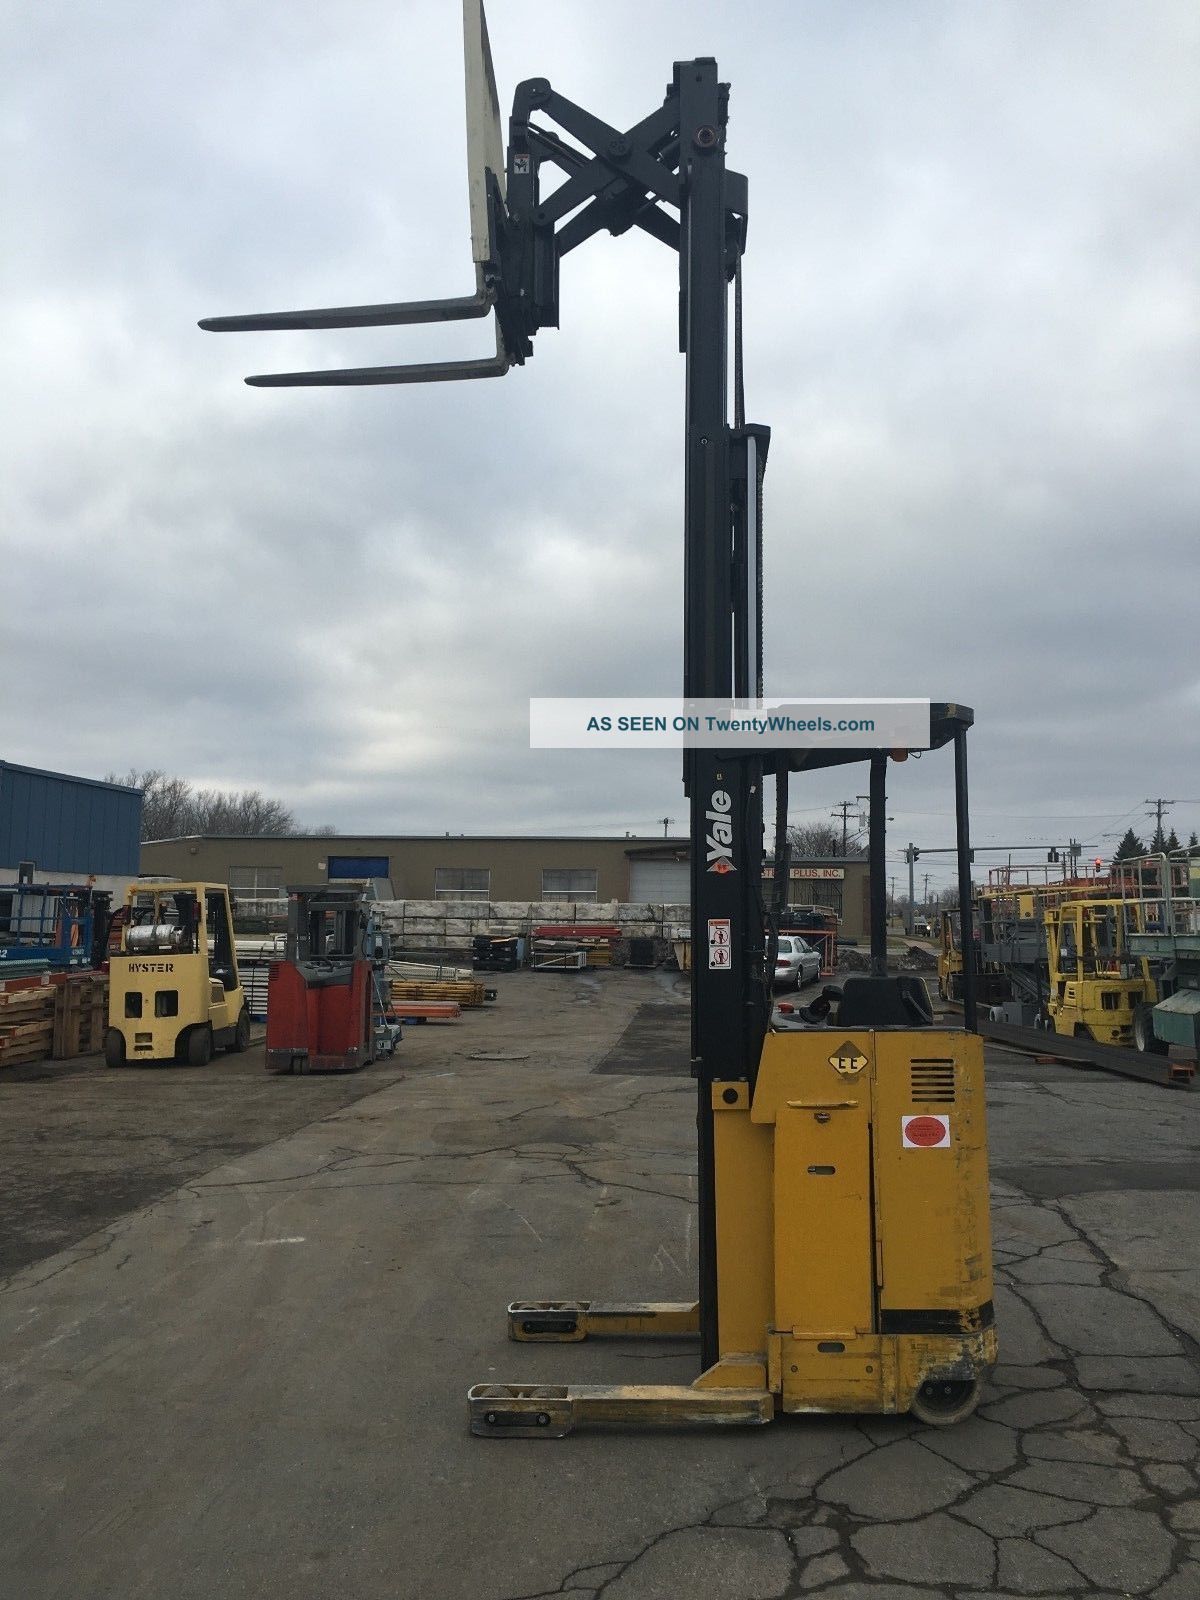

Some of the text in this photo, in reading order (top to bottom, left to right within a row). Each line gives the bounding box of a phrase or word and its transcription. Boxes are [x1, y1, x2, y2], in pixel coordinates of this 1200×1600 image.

[705, 789, 733, 862] Yale
[823, 869, 841, 878] INC.
[128, 963, 174, 973] HYSTER
